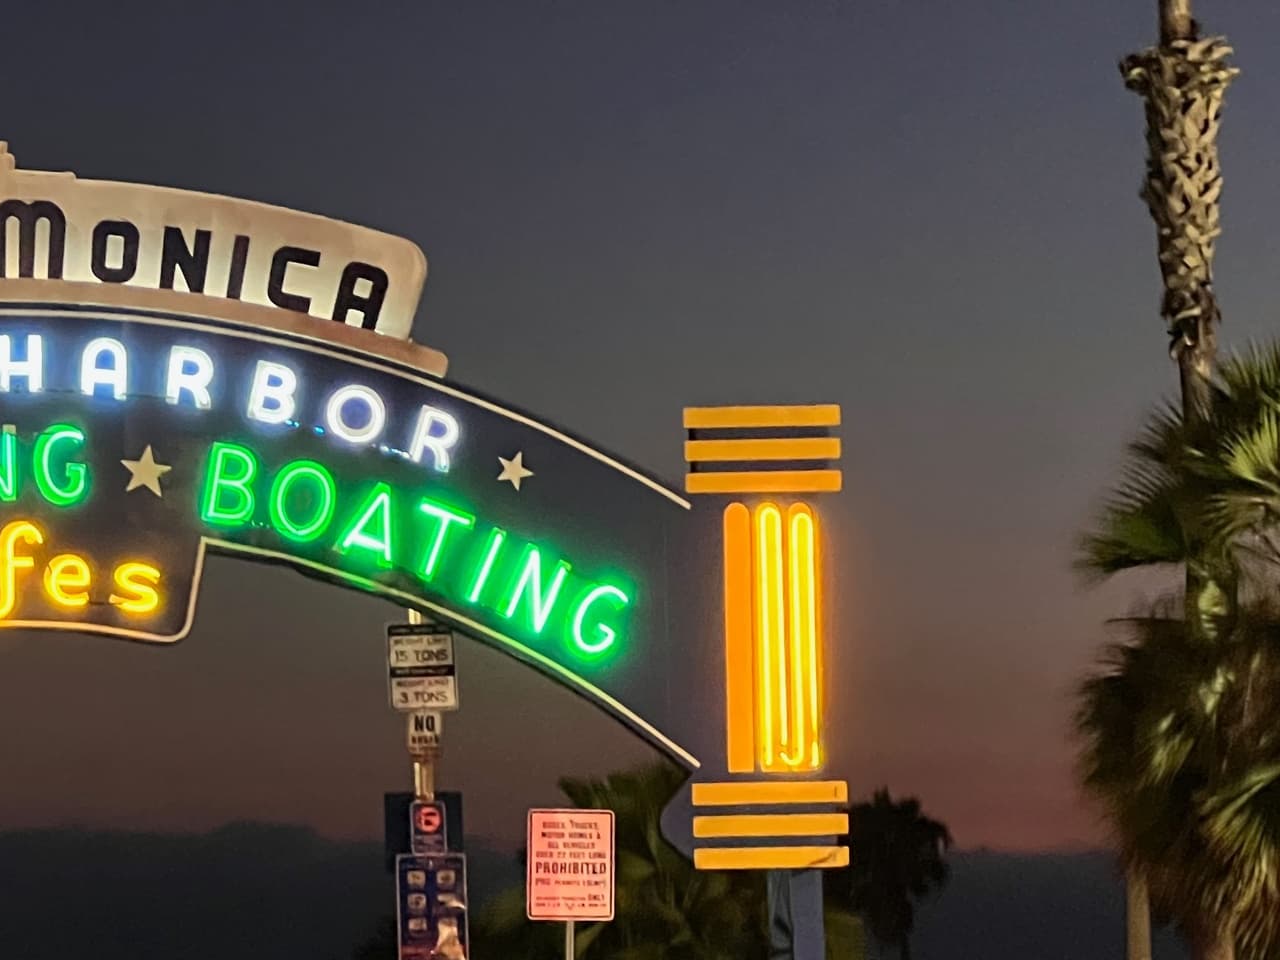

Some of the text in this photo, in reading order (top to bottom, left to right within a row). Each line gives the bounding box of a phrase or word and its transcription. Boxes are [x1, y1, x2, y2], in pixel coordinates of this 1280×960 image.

[201, 441, 633, 664] BOATING
[395, 649, 448, 662] 15 TONS
[400, 691, 448, 703] 3 TONS
[415, 715, 435, 731] NO
[535, 862, 607, 874] PROHIBITED
